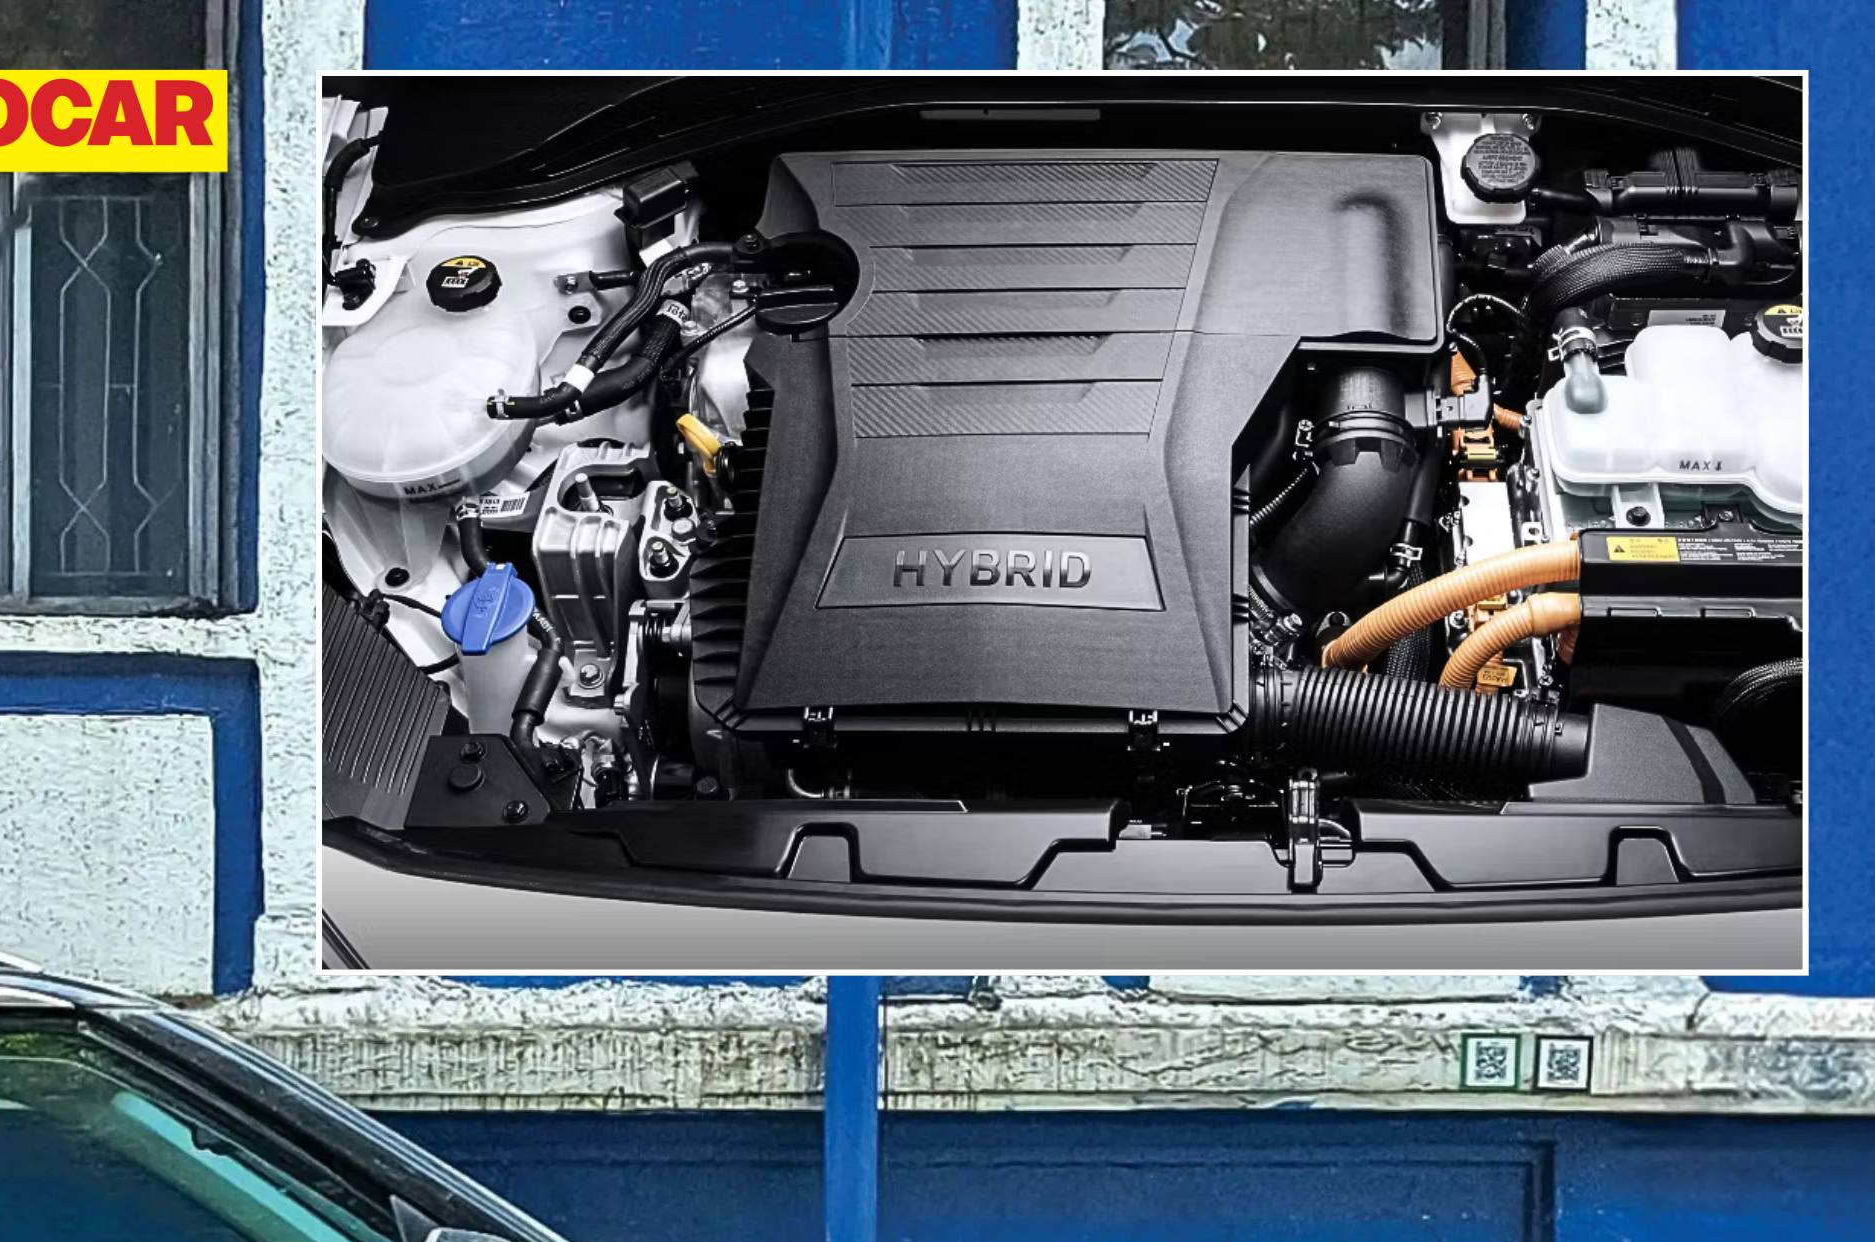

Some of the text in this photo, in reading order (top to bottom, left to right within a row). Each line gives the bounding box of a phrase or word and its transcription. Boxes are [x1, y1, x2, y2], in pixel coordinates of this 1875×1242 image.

[1678, 459, 1711, 471] MAX
[403, 482, 437, 495] MAX
[893, 549, 1092, 588] HYBRID
